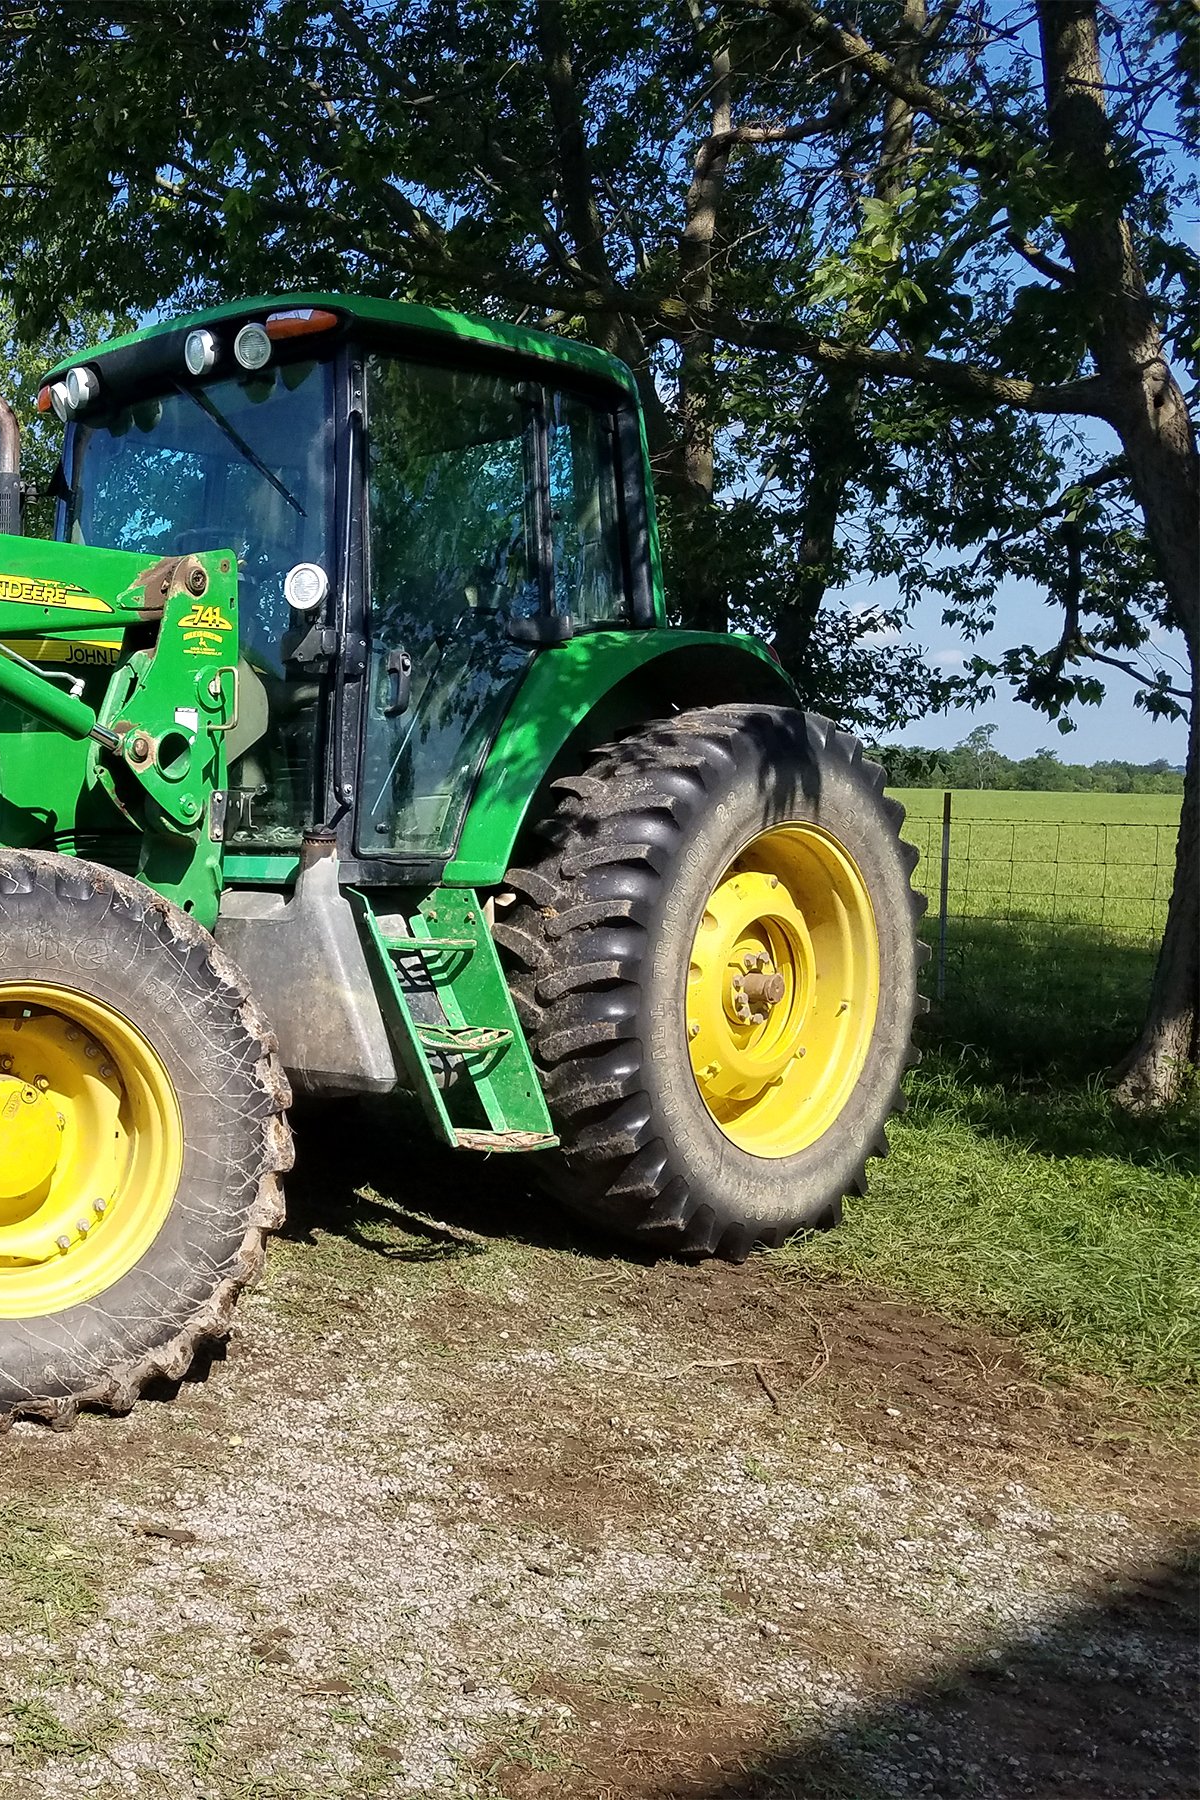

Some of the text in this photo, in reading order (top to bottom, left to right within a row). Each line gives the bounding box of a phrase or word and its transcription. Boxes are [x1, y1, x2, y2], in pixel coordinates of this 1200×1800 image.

[7, 580, 67, 604] DEERE
[192, 604, 220, 627] 741
[65, 645, 107, 664] JOHN
[651, 830, 711, 980] TRACTION
